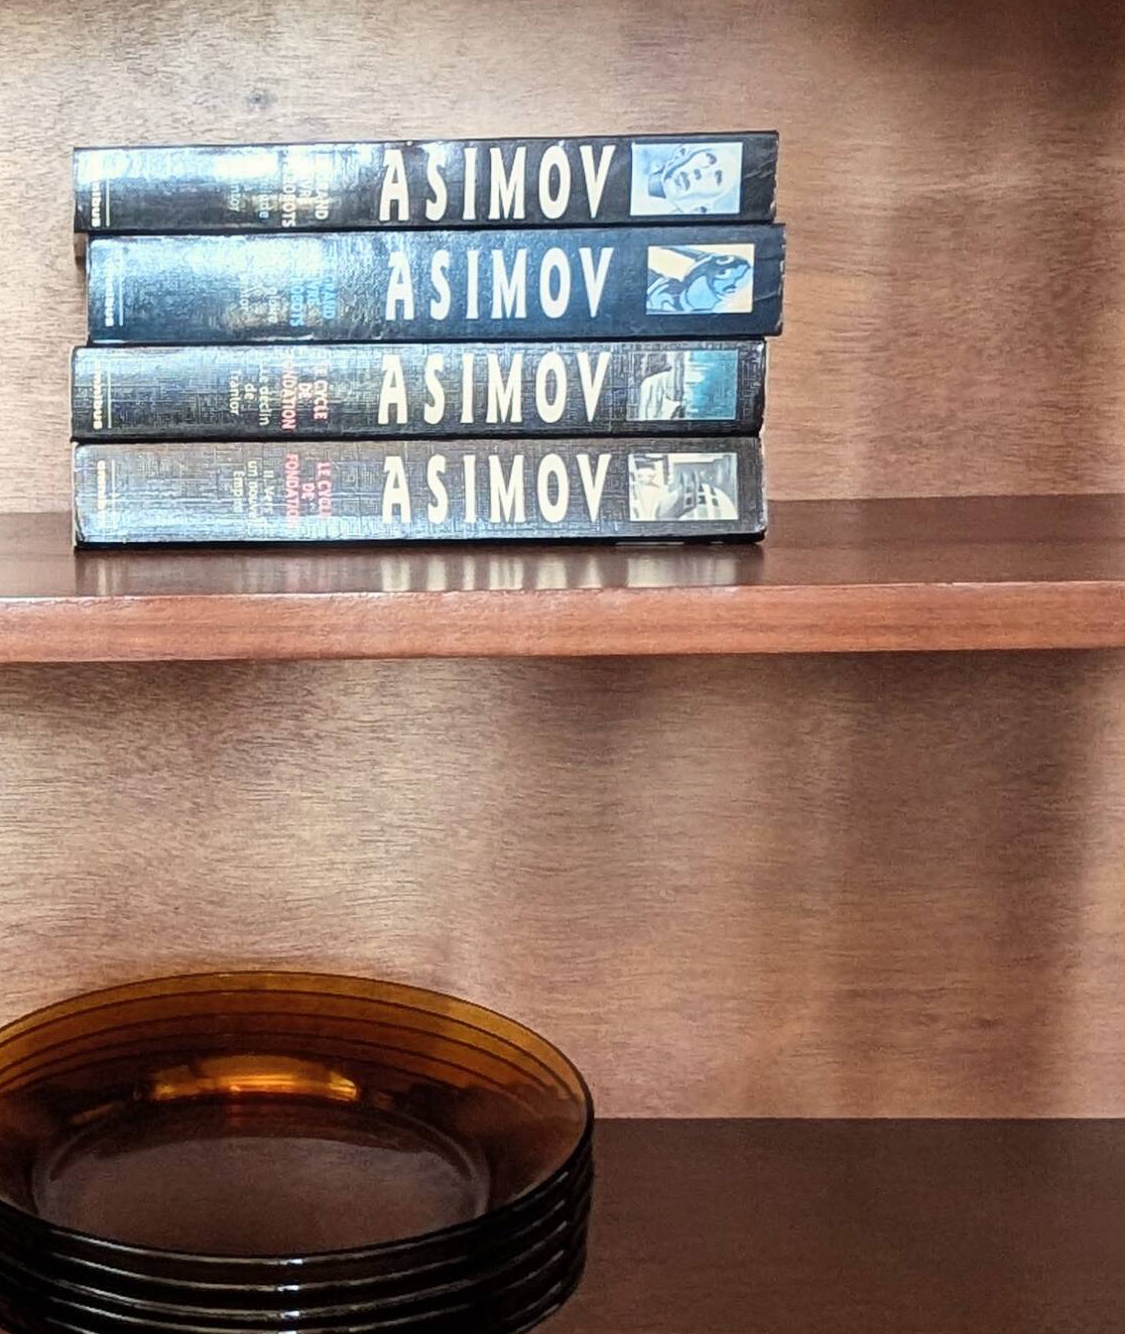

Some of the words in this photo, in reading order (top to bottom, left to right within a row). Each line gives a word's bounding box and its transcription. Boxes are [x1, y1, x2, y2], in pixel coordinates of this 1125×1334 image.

[379, 145, 615, 221] ASIMOV
[385, 247, 613, 320] ASIMOV
[314, 380, 329, 420] CYCLE
[378, 351, 611, 424] ASIMOV
[317, 462, 331, 477] LE
[382, 453, 612, 523] ASIMOV
